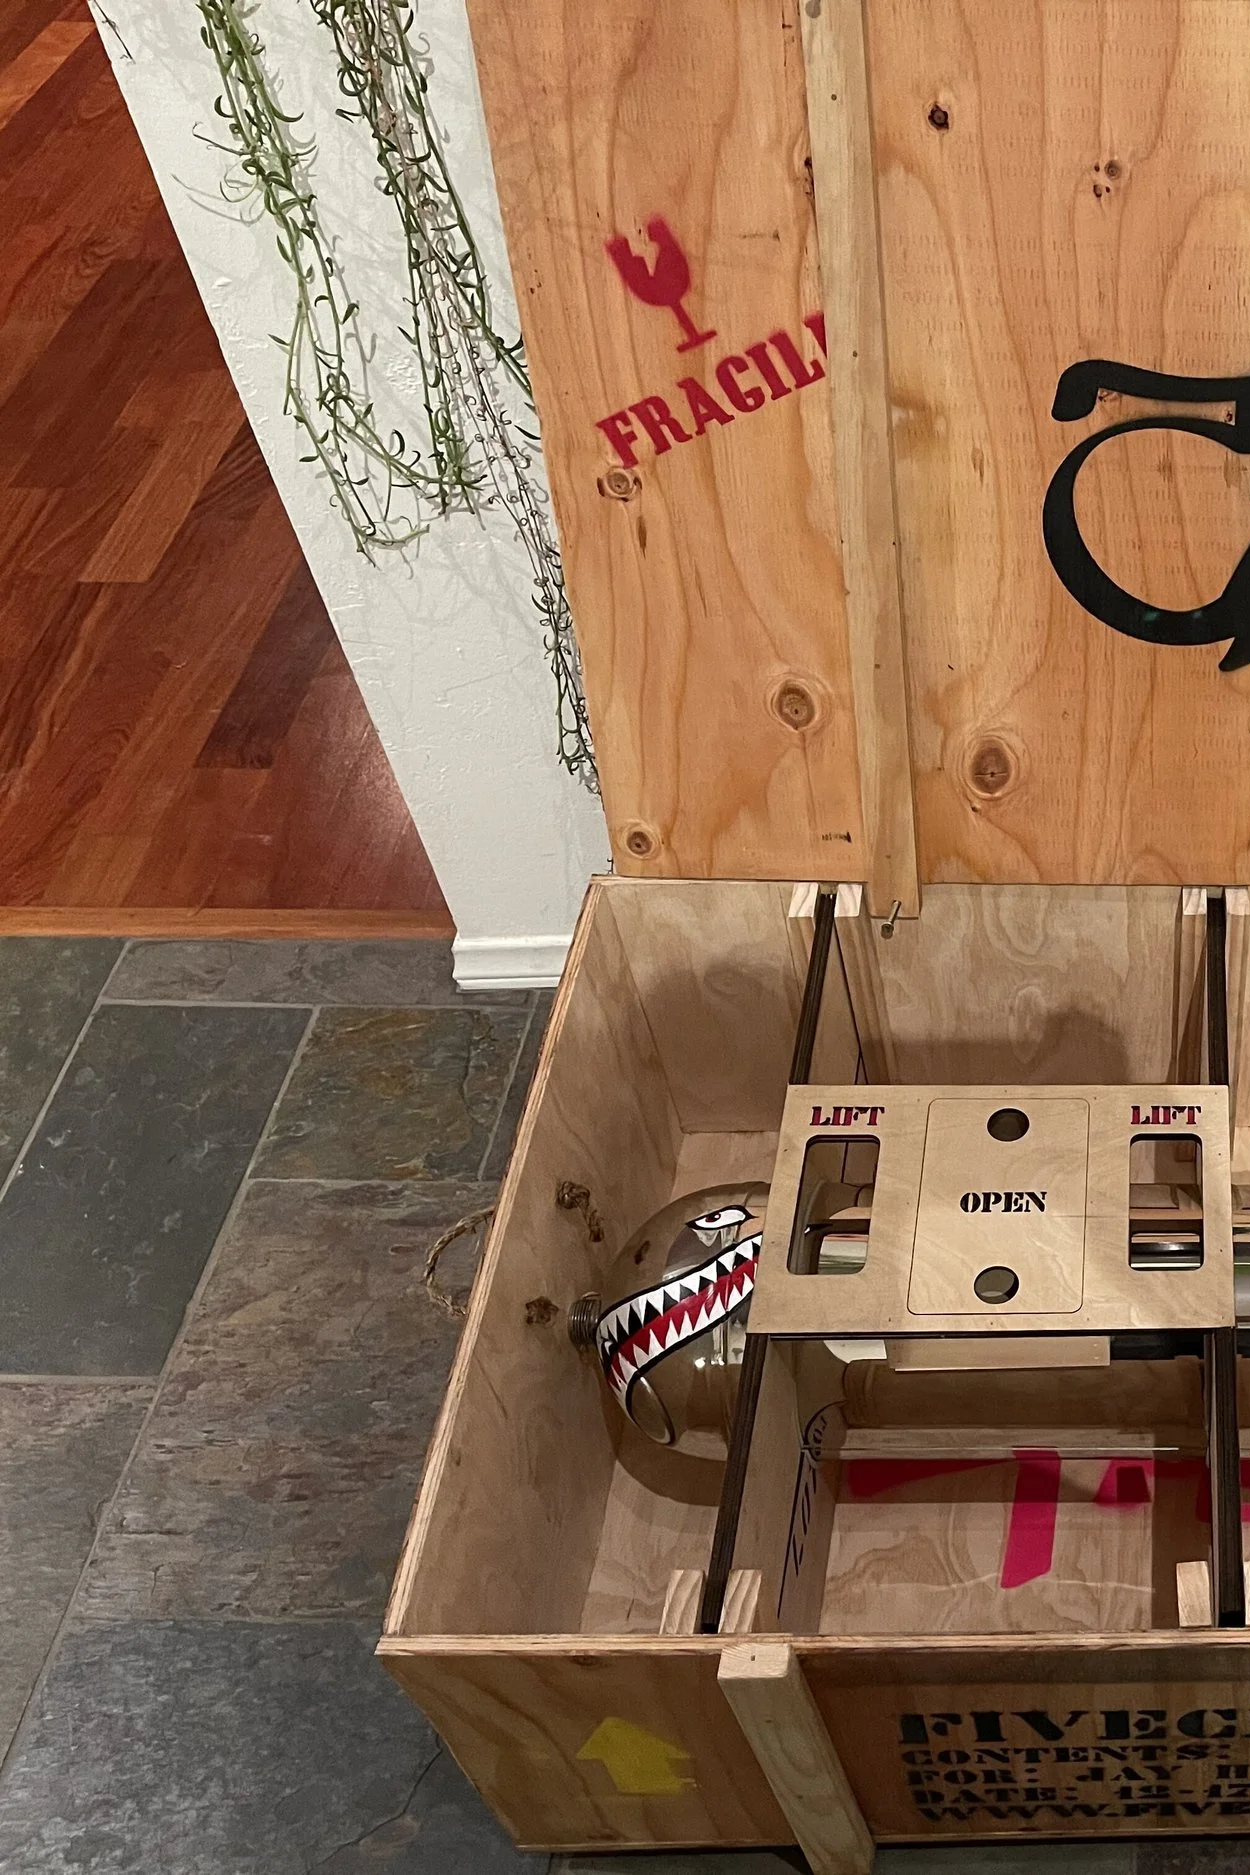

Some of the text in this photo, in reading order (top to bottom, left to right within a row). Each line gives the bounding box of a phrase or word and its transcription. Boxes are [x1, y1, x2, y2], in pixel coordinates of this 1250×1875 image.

[809, 1105, 885, 1127] LIFT
[1130, 1105, 1202, 1126] LIFT
[959, 1191, 1048, 1214] OPEN
[902, 1744, 1231, 1766] CONTENTS:
[907, 1766, 1040, 1786] FOR:
[1075, 1764, 1183, 1783] JAY
[911, 1786, 1079, 1804] DATE:
